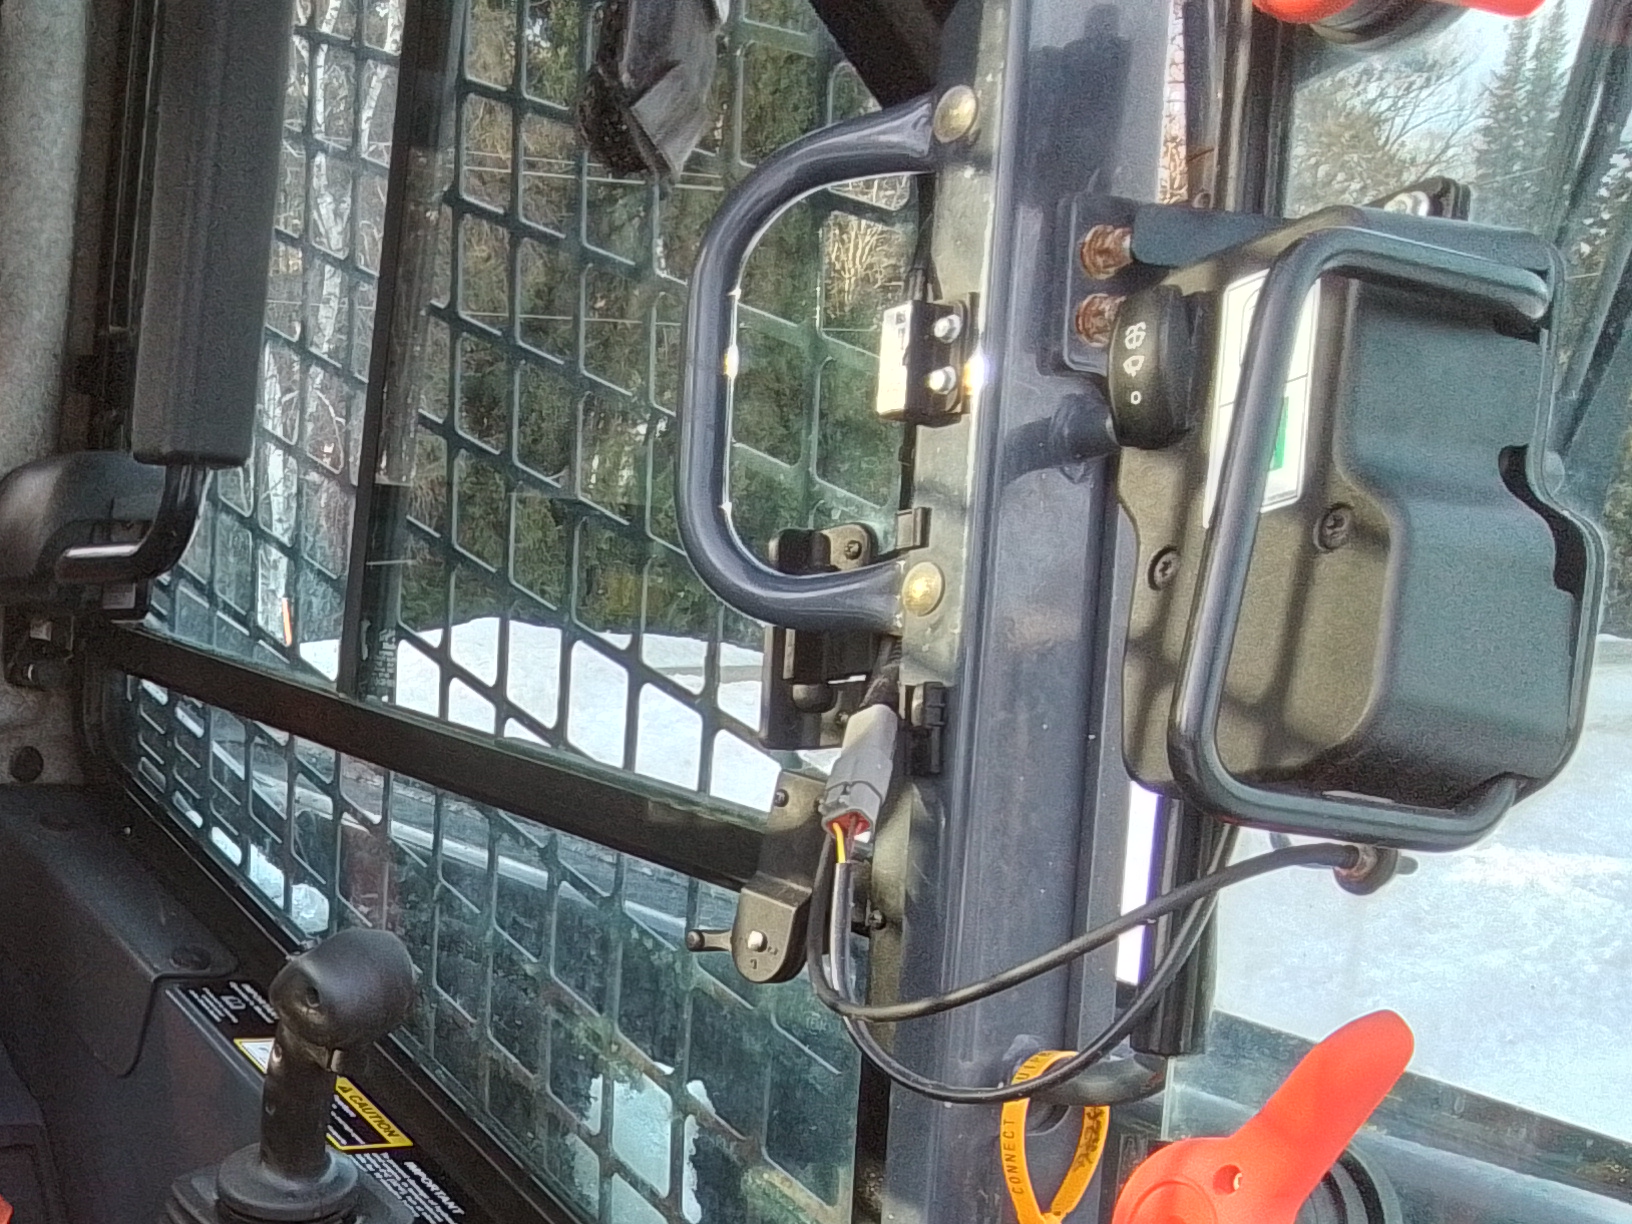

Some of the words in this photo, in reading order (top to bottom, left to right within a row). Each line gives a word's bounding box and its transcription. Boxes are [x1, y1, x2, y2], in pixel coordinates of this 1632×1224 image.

[349, 1094, 401, 1138] CAUTION
[1002, 1119, 1025, 1195] CONNECT
[404, 1161, 465, 1215] IMPORTANT
